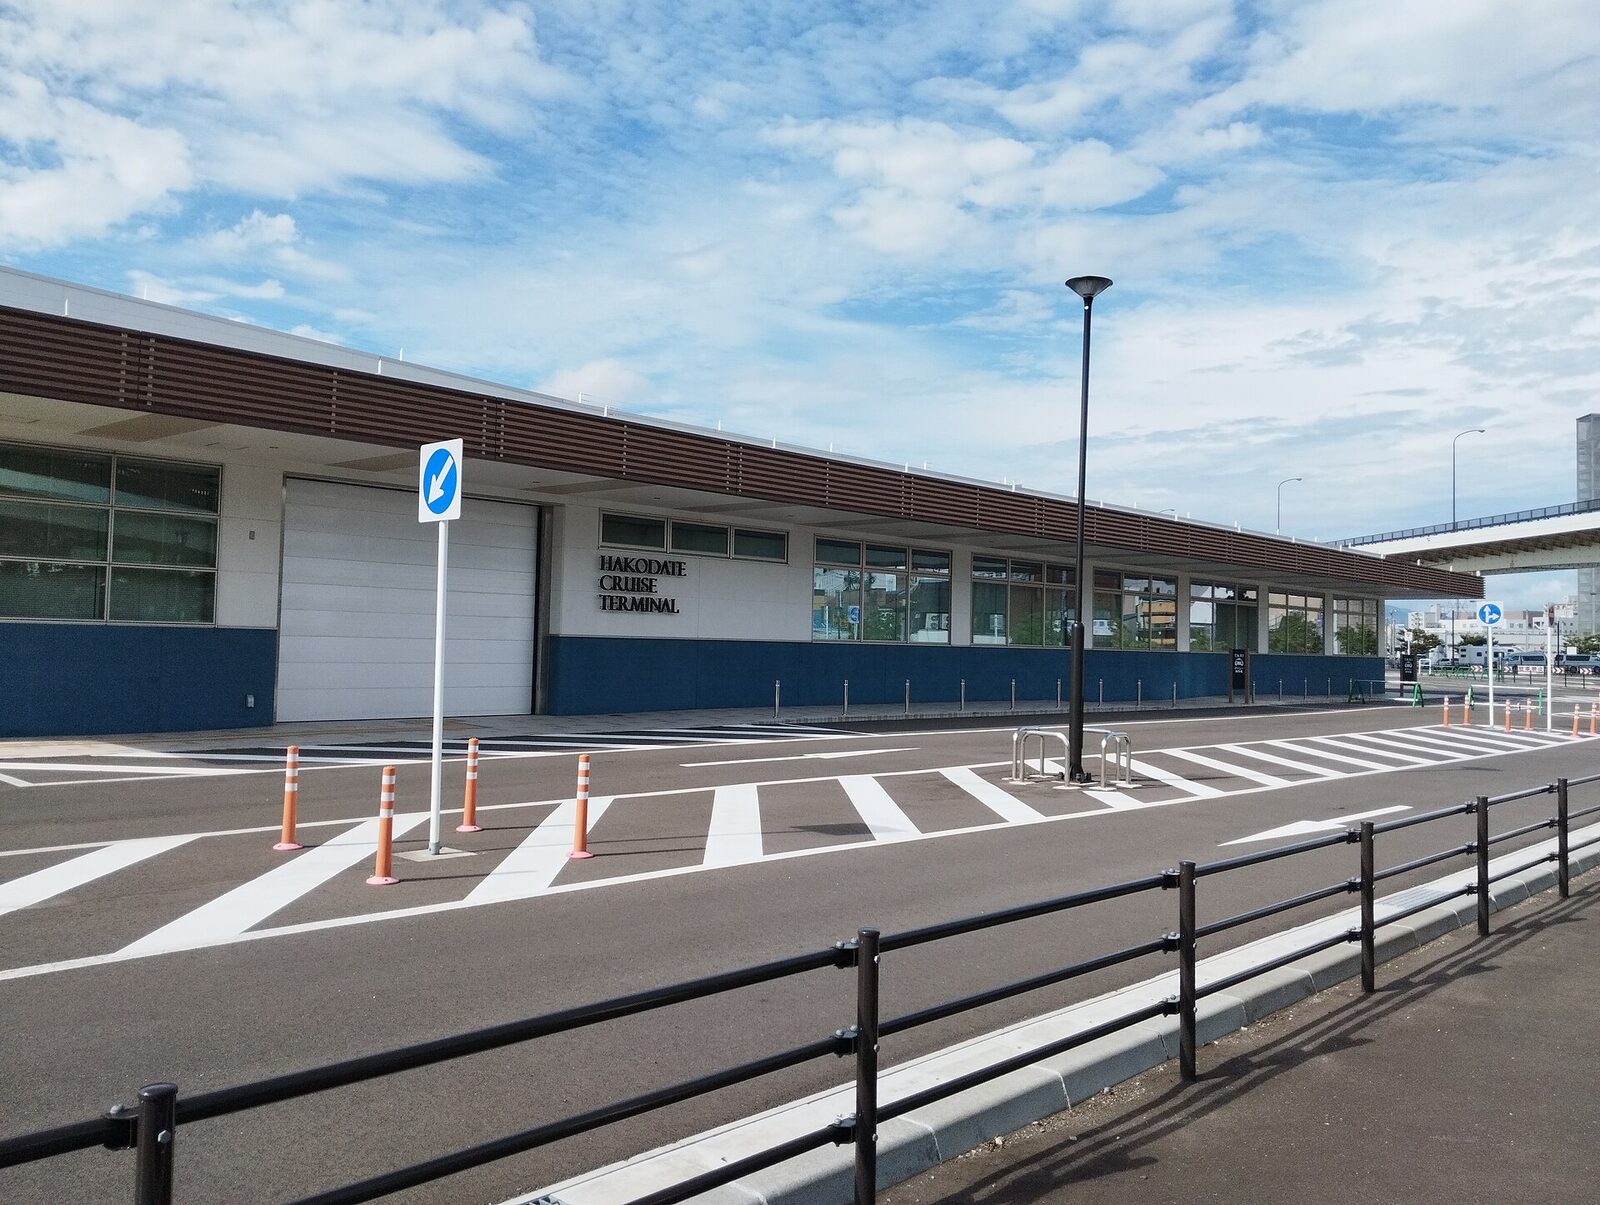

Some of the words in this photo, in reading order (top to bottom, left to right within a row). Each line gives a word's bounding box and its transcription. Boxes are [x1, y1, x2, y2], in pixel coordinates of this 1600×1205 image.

[600, 555, 687, 577] HAKODATE
[600, 575, 658, 594] CRUISE
[599, 594, 680, 613] TERMINAL
